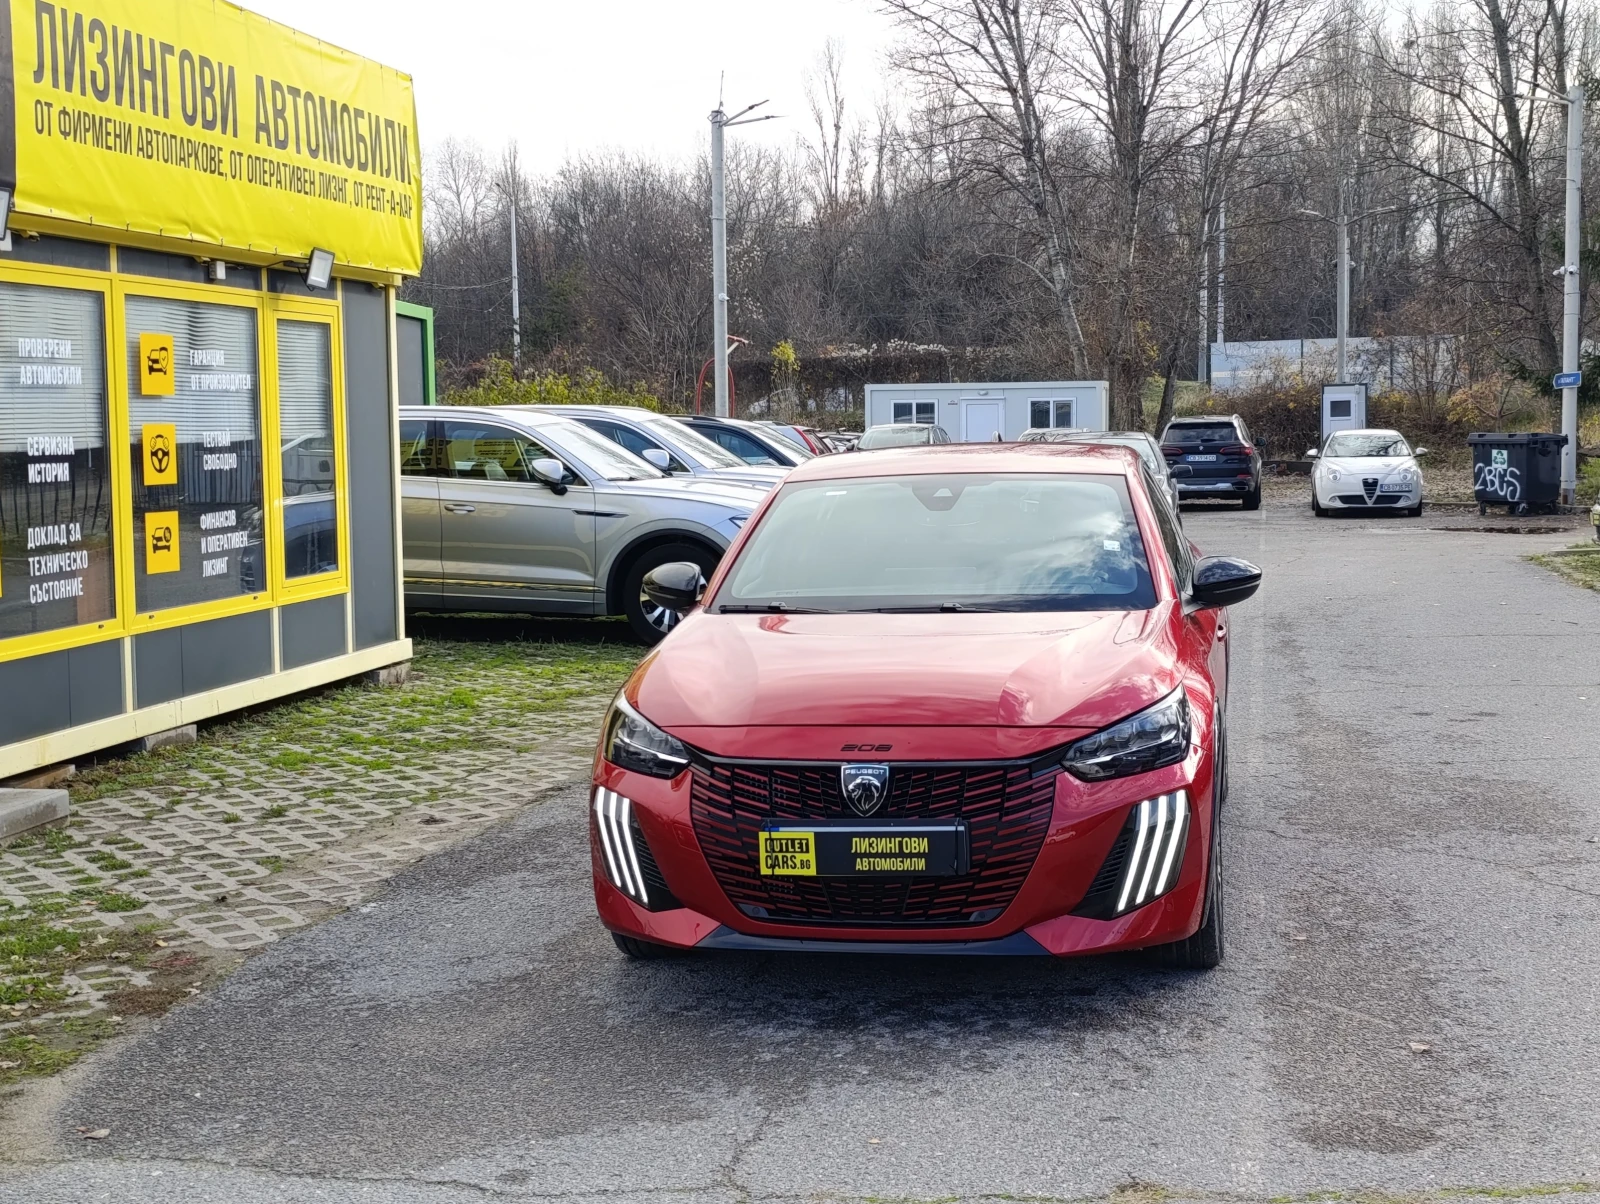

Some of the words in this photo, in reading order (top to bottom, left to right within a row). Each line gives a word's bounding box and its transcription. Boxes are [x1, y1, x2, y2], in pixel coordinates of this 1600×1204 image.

[33, 0, 239, 138] ЛИЗИНГОВИ
[255, 74, 412, 186] АВТОМОБИЛИ
[35, 98, 53, 137] ОТ
[58, 105, 132, 155] ФИРМЕНИ
[136, 125, 228, 181] АВТОПАРКОВЕ,
[230, 150, 244, 179] ОТ
[247, 156, 316, 197] ОПЕРАТИВЕН
[353, 180, 364, 208] ОТ
[18, 337, 72, 358] ПРОВЕРЕНИ
[189, 349, 225, 367] ГАРАНЦИЯ
[20, 365, 82, 385] АВТОМОБИЛИ
[27, 436, 75, 456] СЕРВИЗНА
[202, 430, 231, 447] ТЕСТВАЙ
[203, 453, 238, 471] СВОБОДНО
[28, 462, 70, 484] ИСТОРИЯ
[200, 510, 236, 530] ФИНАНСОВ
[27, 523, 68, 550] ДОКЛАД
[69, 522, 82, 542] ЗА
[201, 538, 207, 554] И
[207, 530, 248, 553] ОПЕРАТИВЕН
[28, 550, 89, 577] ТЕХНИЧЕСКО
[202, 557, 229, 578] ЛИЗИНГ
[29, 577, 84, 604] СЪСТОЯНИЕ
[840, 744, 893, 752] 208
[766, 839, 808, 852] OUTLET
[851, 837, 929, 854] ЛИЗИНГОВИ
[855, 857, 926, 871] АВТОМОБИЛИ
